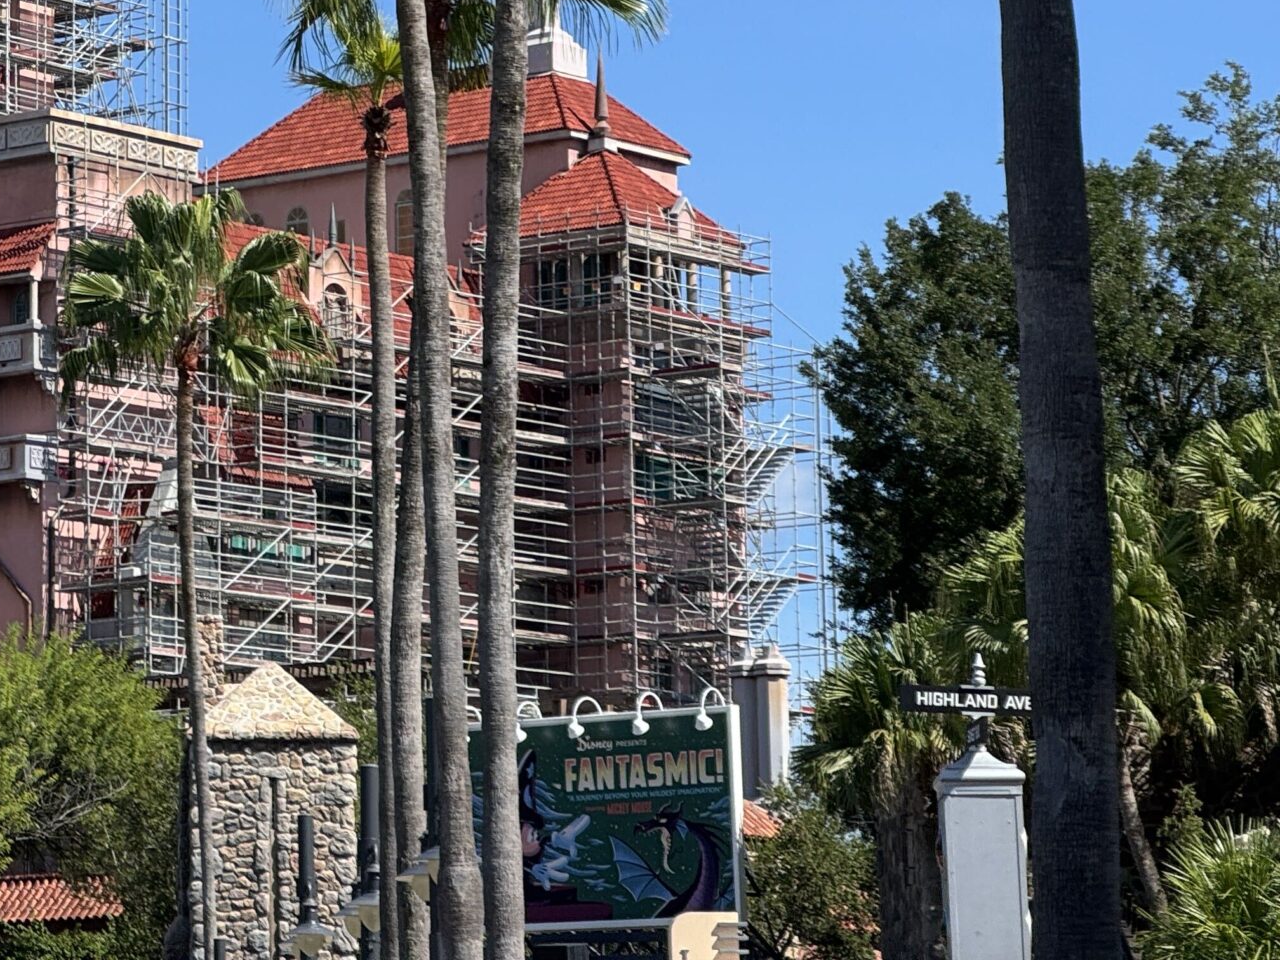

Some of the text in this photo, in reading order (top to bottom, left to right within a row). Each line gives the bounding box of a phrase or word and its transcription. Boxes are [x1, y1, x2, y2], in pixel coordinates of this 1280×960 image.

[916, 691, 1032, 711] HIGHLAND AVE
[576, 736, 613, 752] Disney
[564, 748, 724, 792] FANTASMIC!
